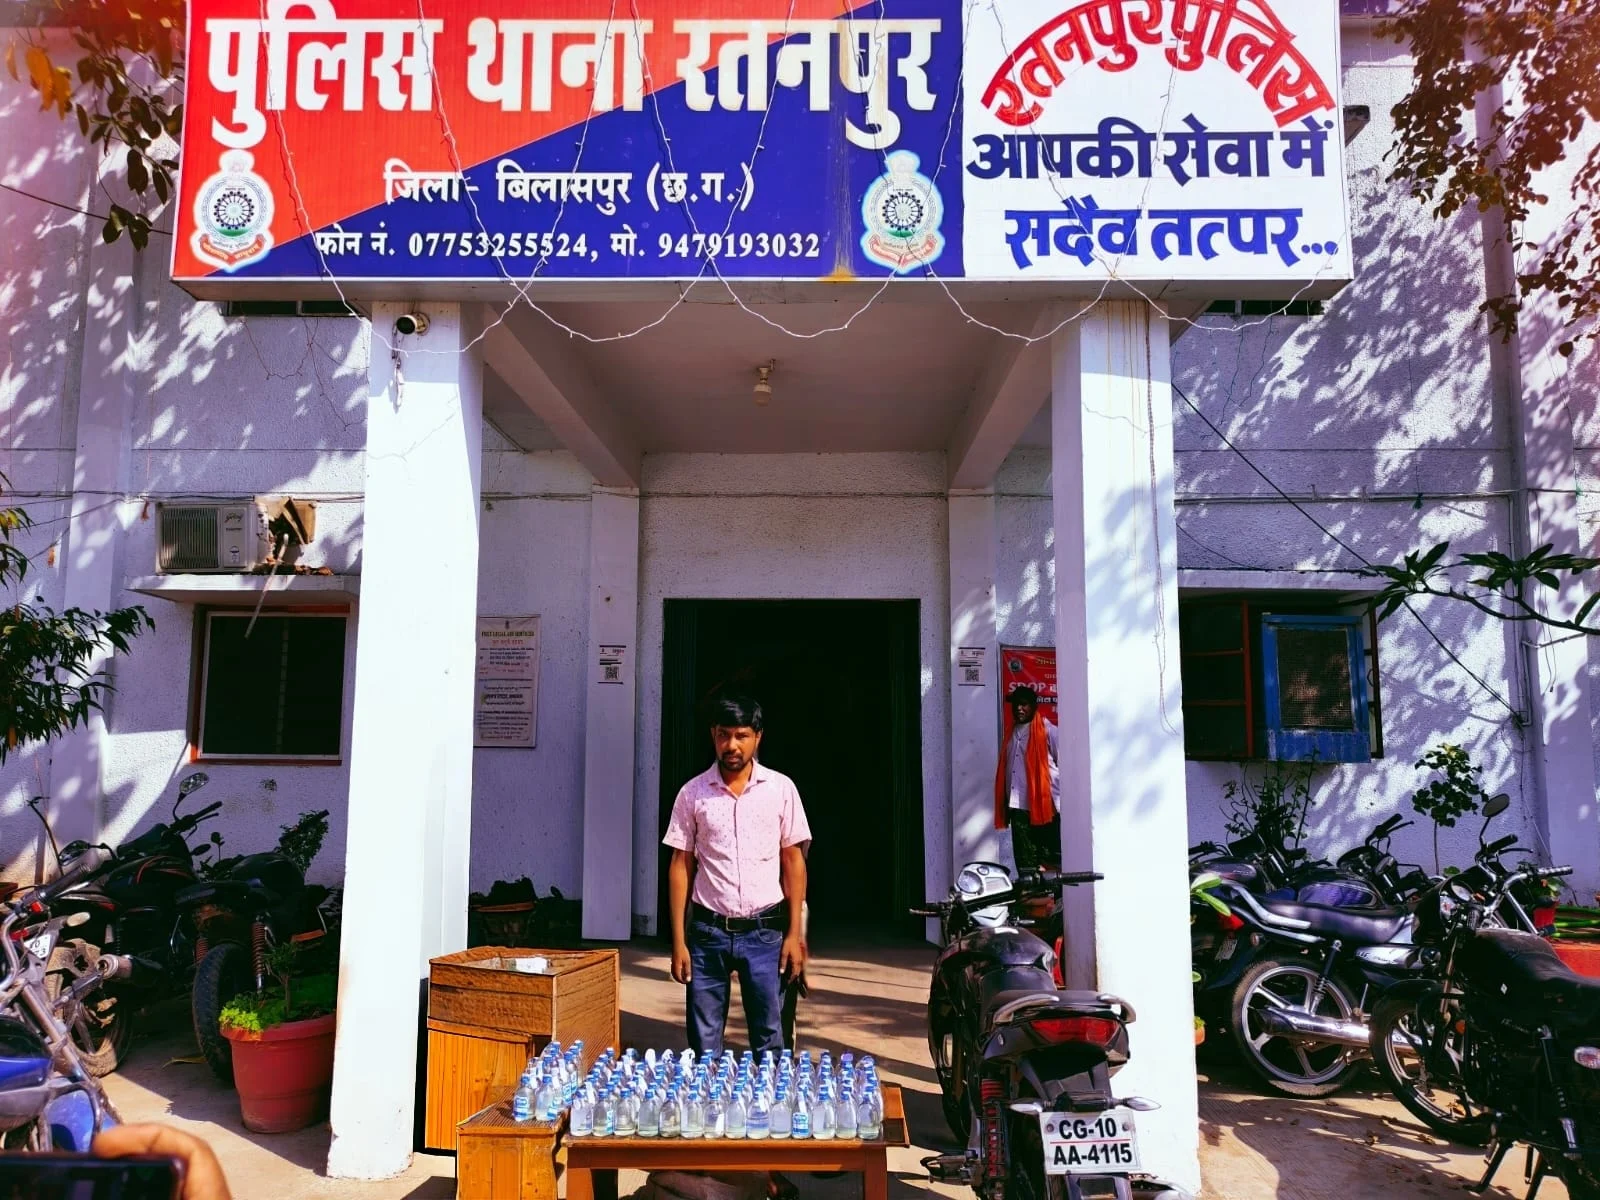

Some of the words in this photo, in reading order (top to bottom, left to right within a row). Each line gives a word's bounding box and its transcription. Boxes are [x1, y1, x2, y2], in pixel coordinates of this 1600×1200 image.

[205, 0, 443, 149] पुलिस
[467, 17, 654, 113] थाना
[674, 18, 942, 150] रतनपुर
[980, 0, 1164, 127] रतनपुर
[965, 115, 1157, 180] आपकी
[1162, 112, 1274, 187] सेवा
[1280, 114, 1335, 177] में
[495, 157, 633, 216] बिलासपुर
[646, 161, 755, 212] (छ.ग.)
[314, 222, 361, 257] फोन
[371, 222, 395, 257] नं.
[408, 232, 599, 263] 07753255524,
[610, 224, 645, 258] मो.
[658, 232, 821, 259] 9479193032
[1004, 194, 1143, 271] सदैव
[1053, 1143, 1132, 1166] AA-4115
[1058, 1117, 1118, 1140] CG-10
